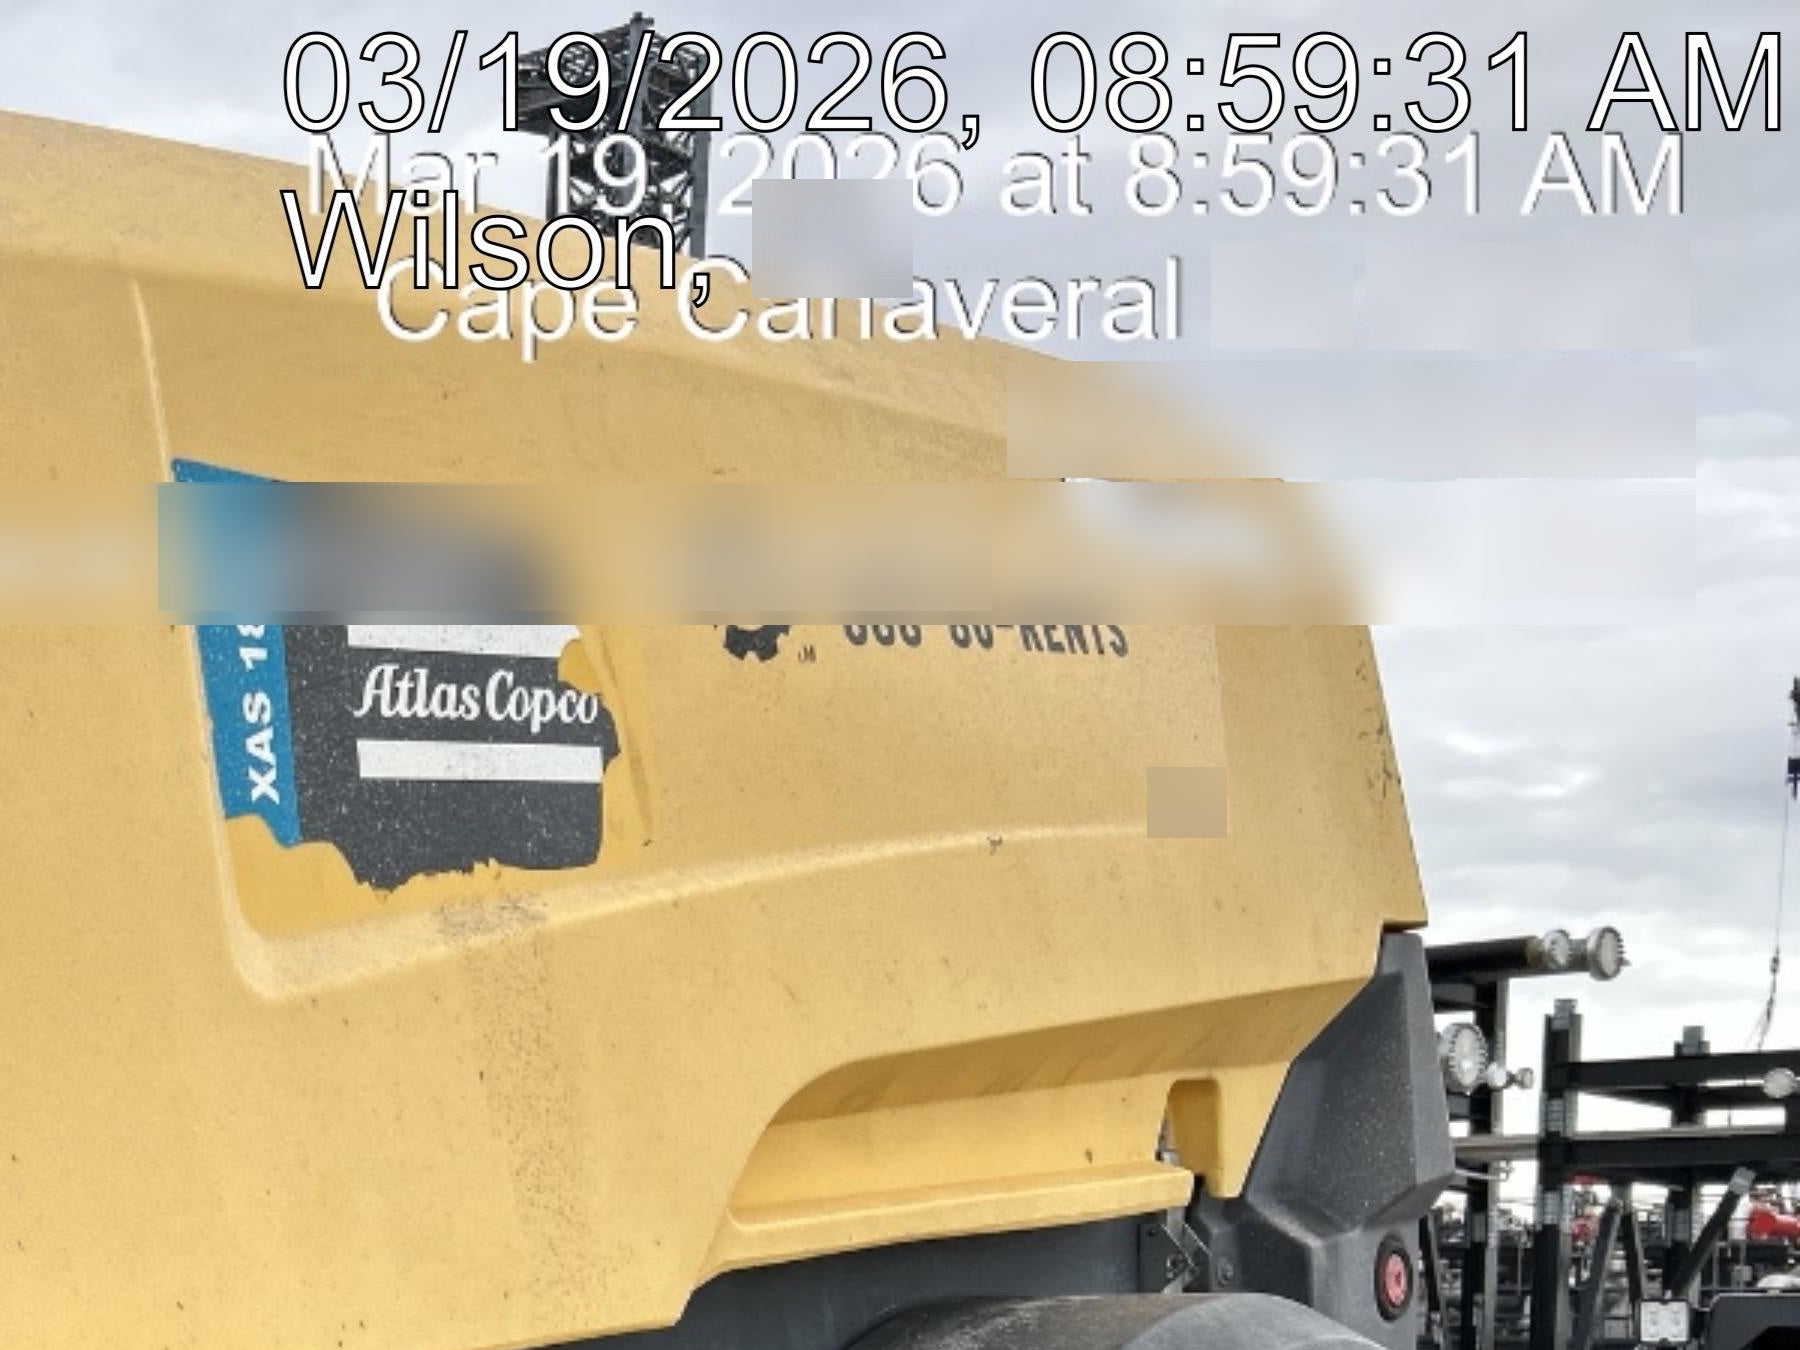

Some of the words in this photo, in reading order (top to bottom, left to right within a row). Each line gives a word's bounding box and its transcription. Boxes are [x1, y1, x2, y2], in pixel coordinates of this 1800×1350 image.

[353, 662, 481, 721] Atlas
[485, 668, 599, 735] Copco
[242, 691, 280, 805] XAS
